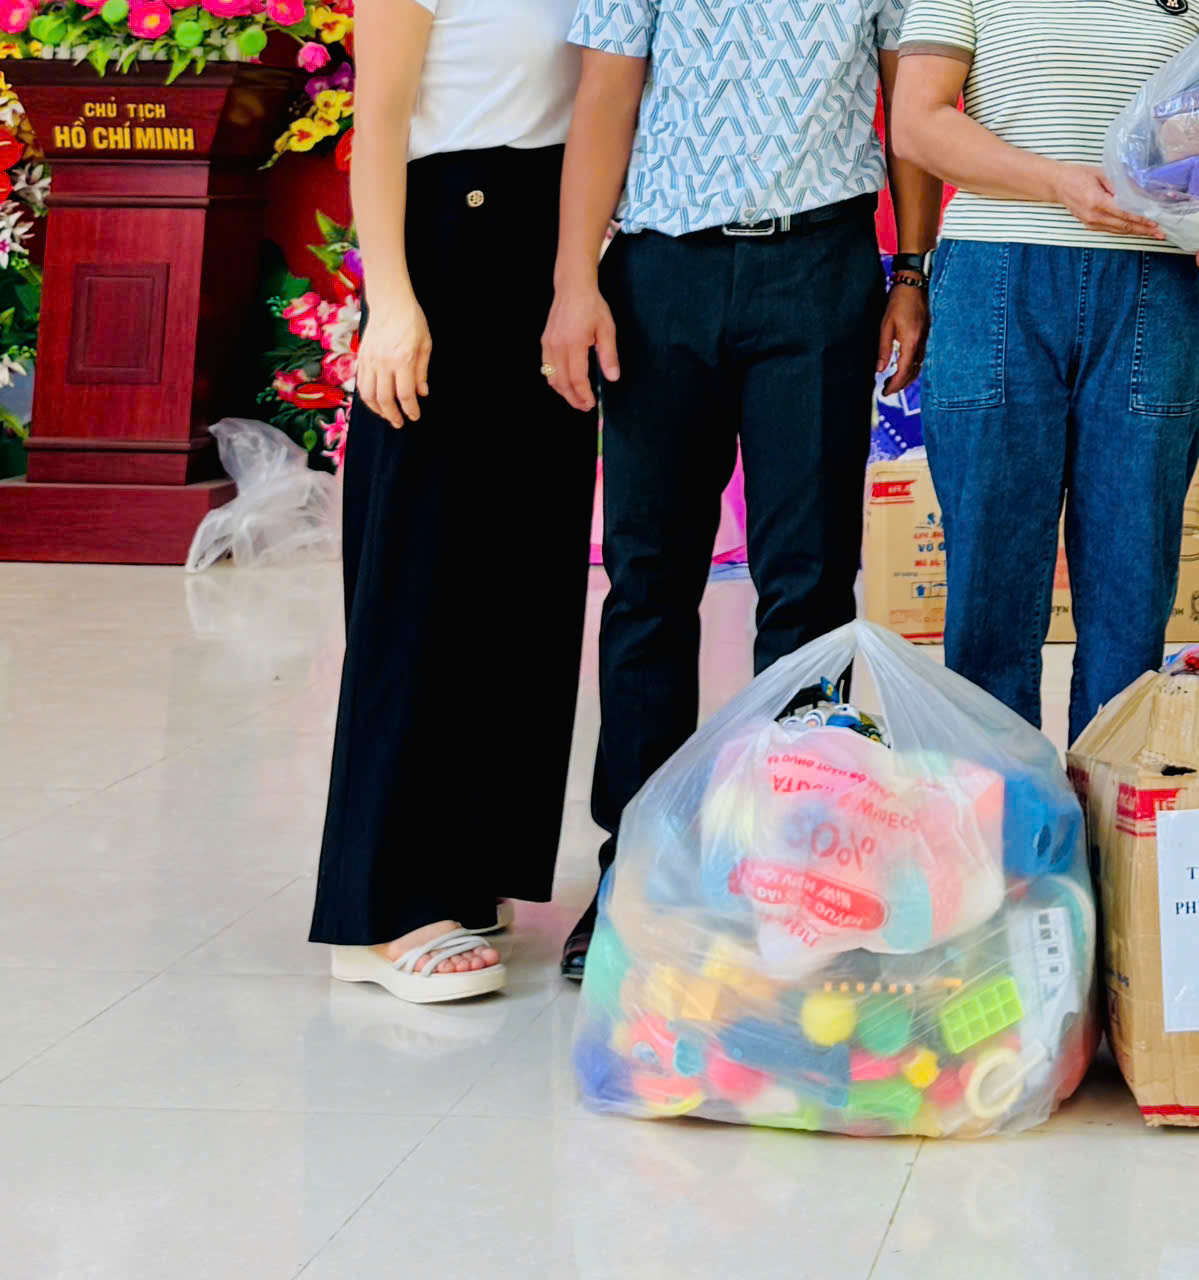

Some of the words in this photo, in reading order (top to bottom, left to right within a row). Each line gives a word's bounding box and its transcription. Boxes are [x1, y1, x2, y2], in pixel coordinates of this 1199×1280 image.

[84, 95, 117, 118] CHỦ
[126, 103, 166, 122] TỊCH
[54, 116, 86, 150] HỒ
[92, 121, 131, 150] CHÍ
[135, 127, 195, 151] MINH
